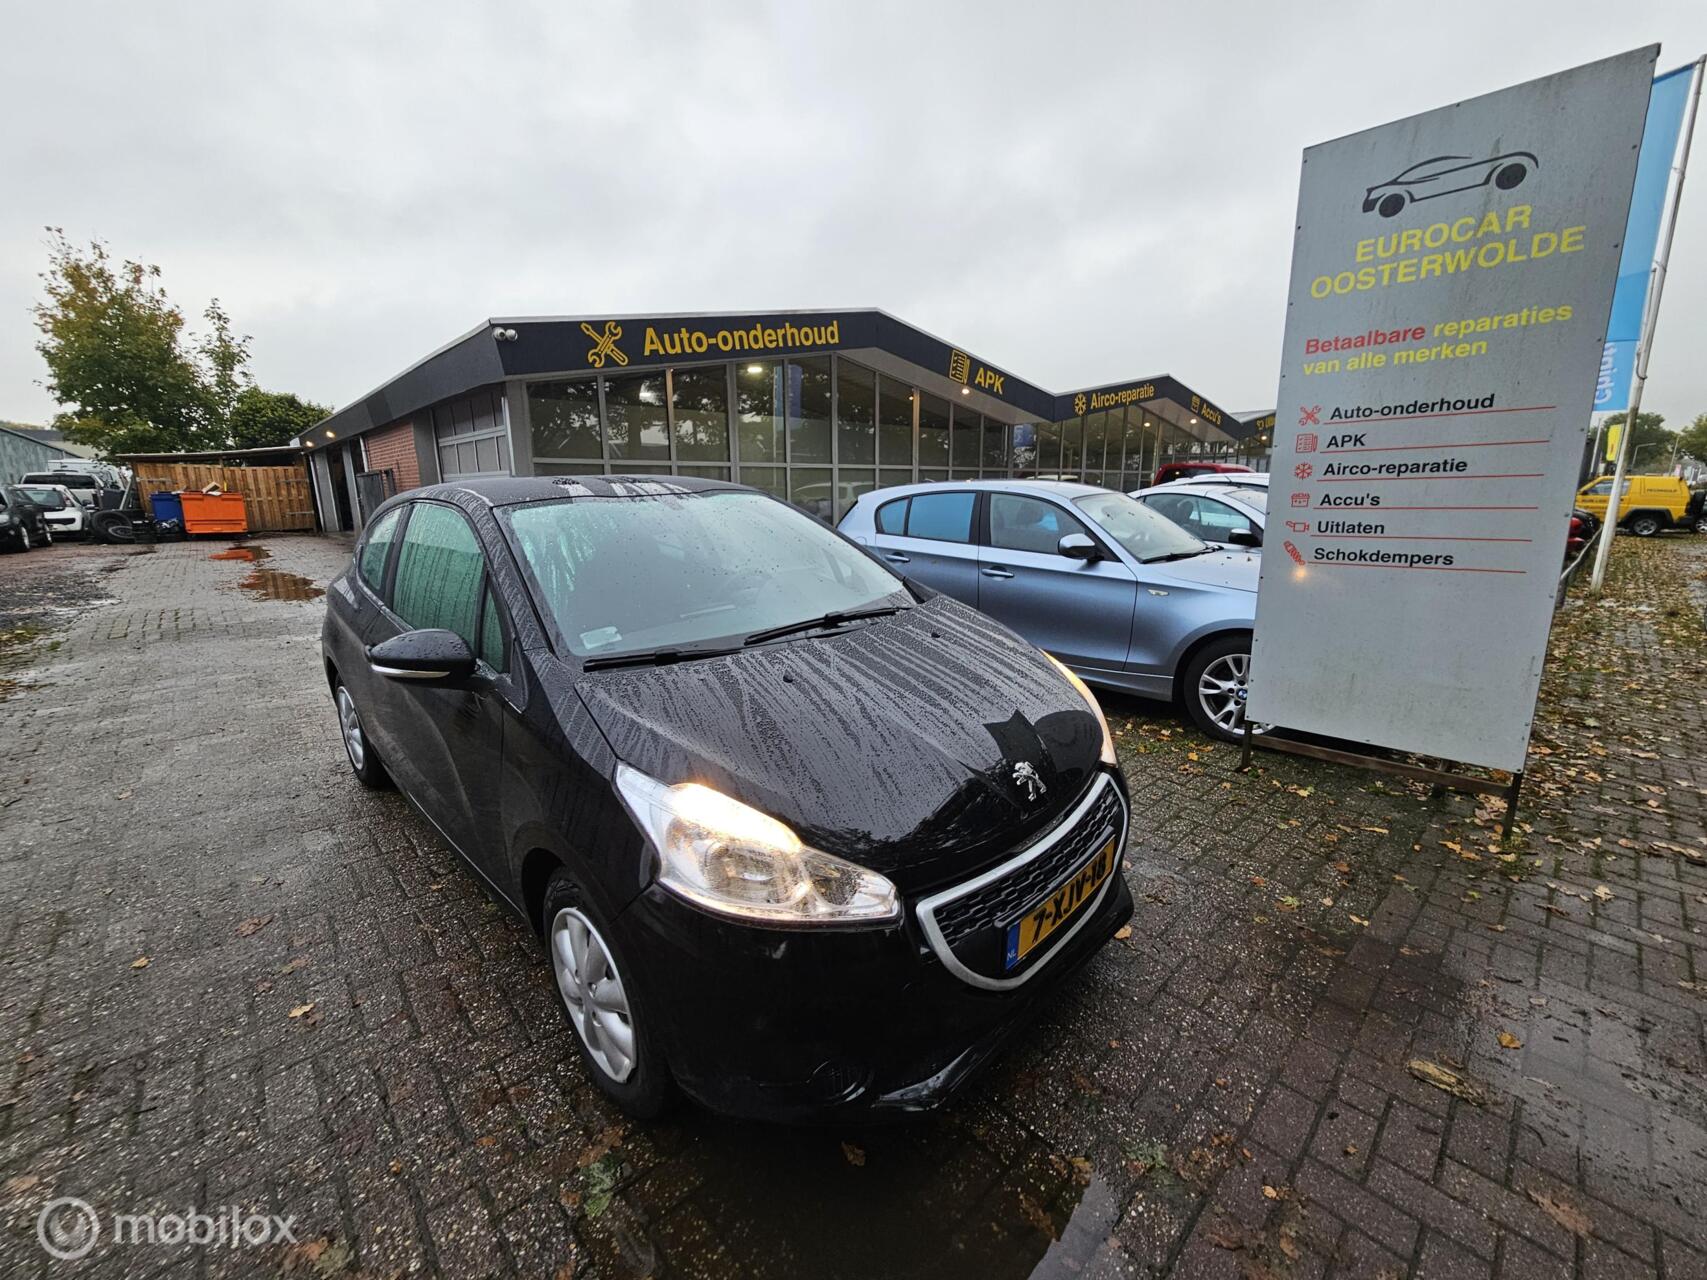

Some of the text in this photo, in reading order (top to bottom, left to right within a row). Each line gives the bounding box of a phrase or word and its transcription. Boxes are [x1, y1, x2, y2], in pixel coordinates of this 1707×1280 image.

[1355, 204, 1533, 263] EUROCAR
[1310, 225, 1587, 299] OOSTERWOLDE
[643, 320, 840, 357] Auto-onderhoud
[1305, 304, 1574, 355] Betaalbare reparaties
[1303, 339, 1488, 376] van alle merken
[974, 367, 1005, 395] APK
[1090, 382, 1155, 410] Airco-reparatie
[1330, 393, 1496, 421] Auto-onderhoud
[1326, 433, 1368, 449] APK
[1323, 457, 1468, 478] Airco-reparatie
[1319, 493, 1381, 507] Accu's
[1316, 520, 1386, 535] Uitlaten
[1313, 547, 1455, 568] Schokdempers
